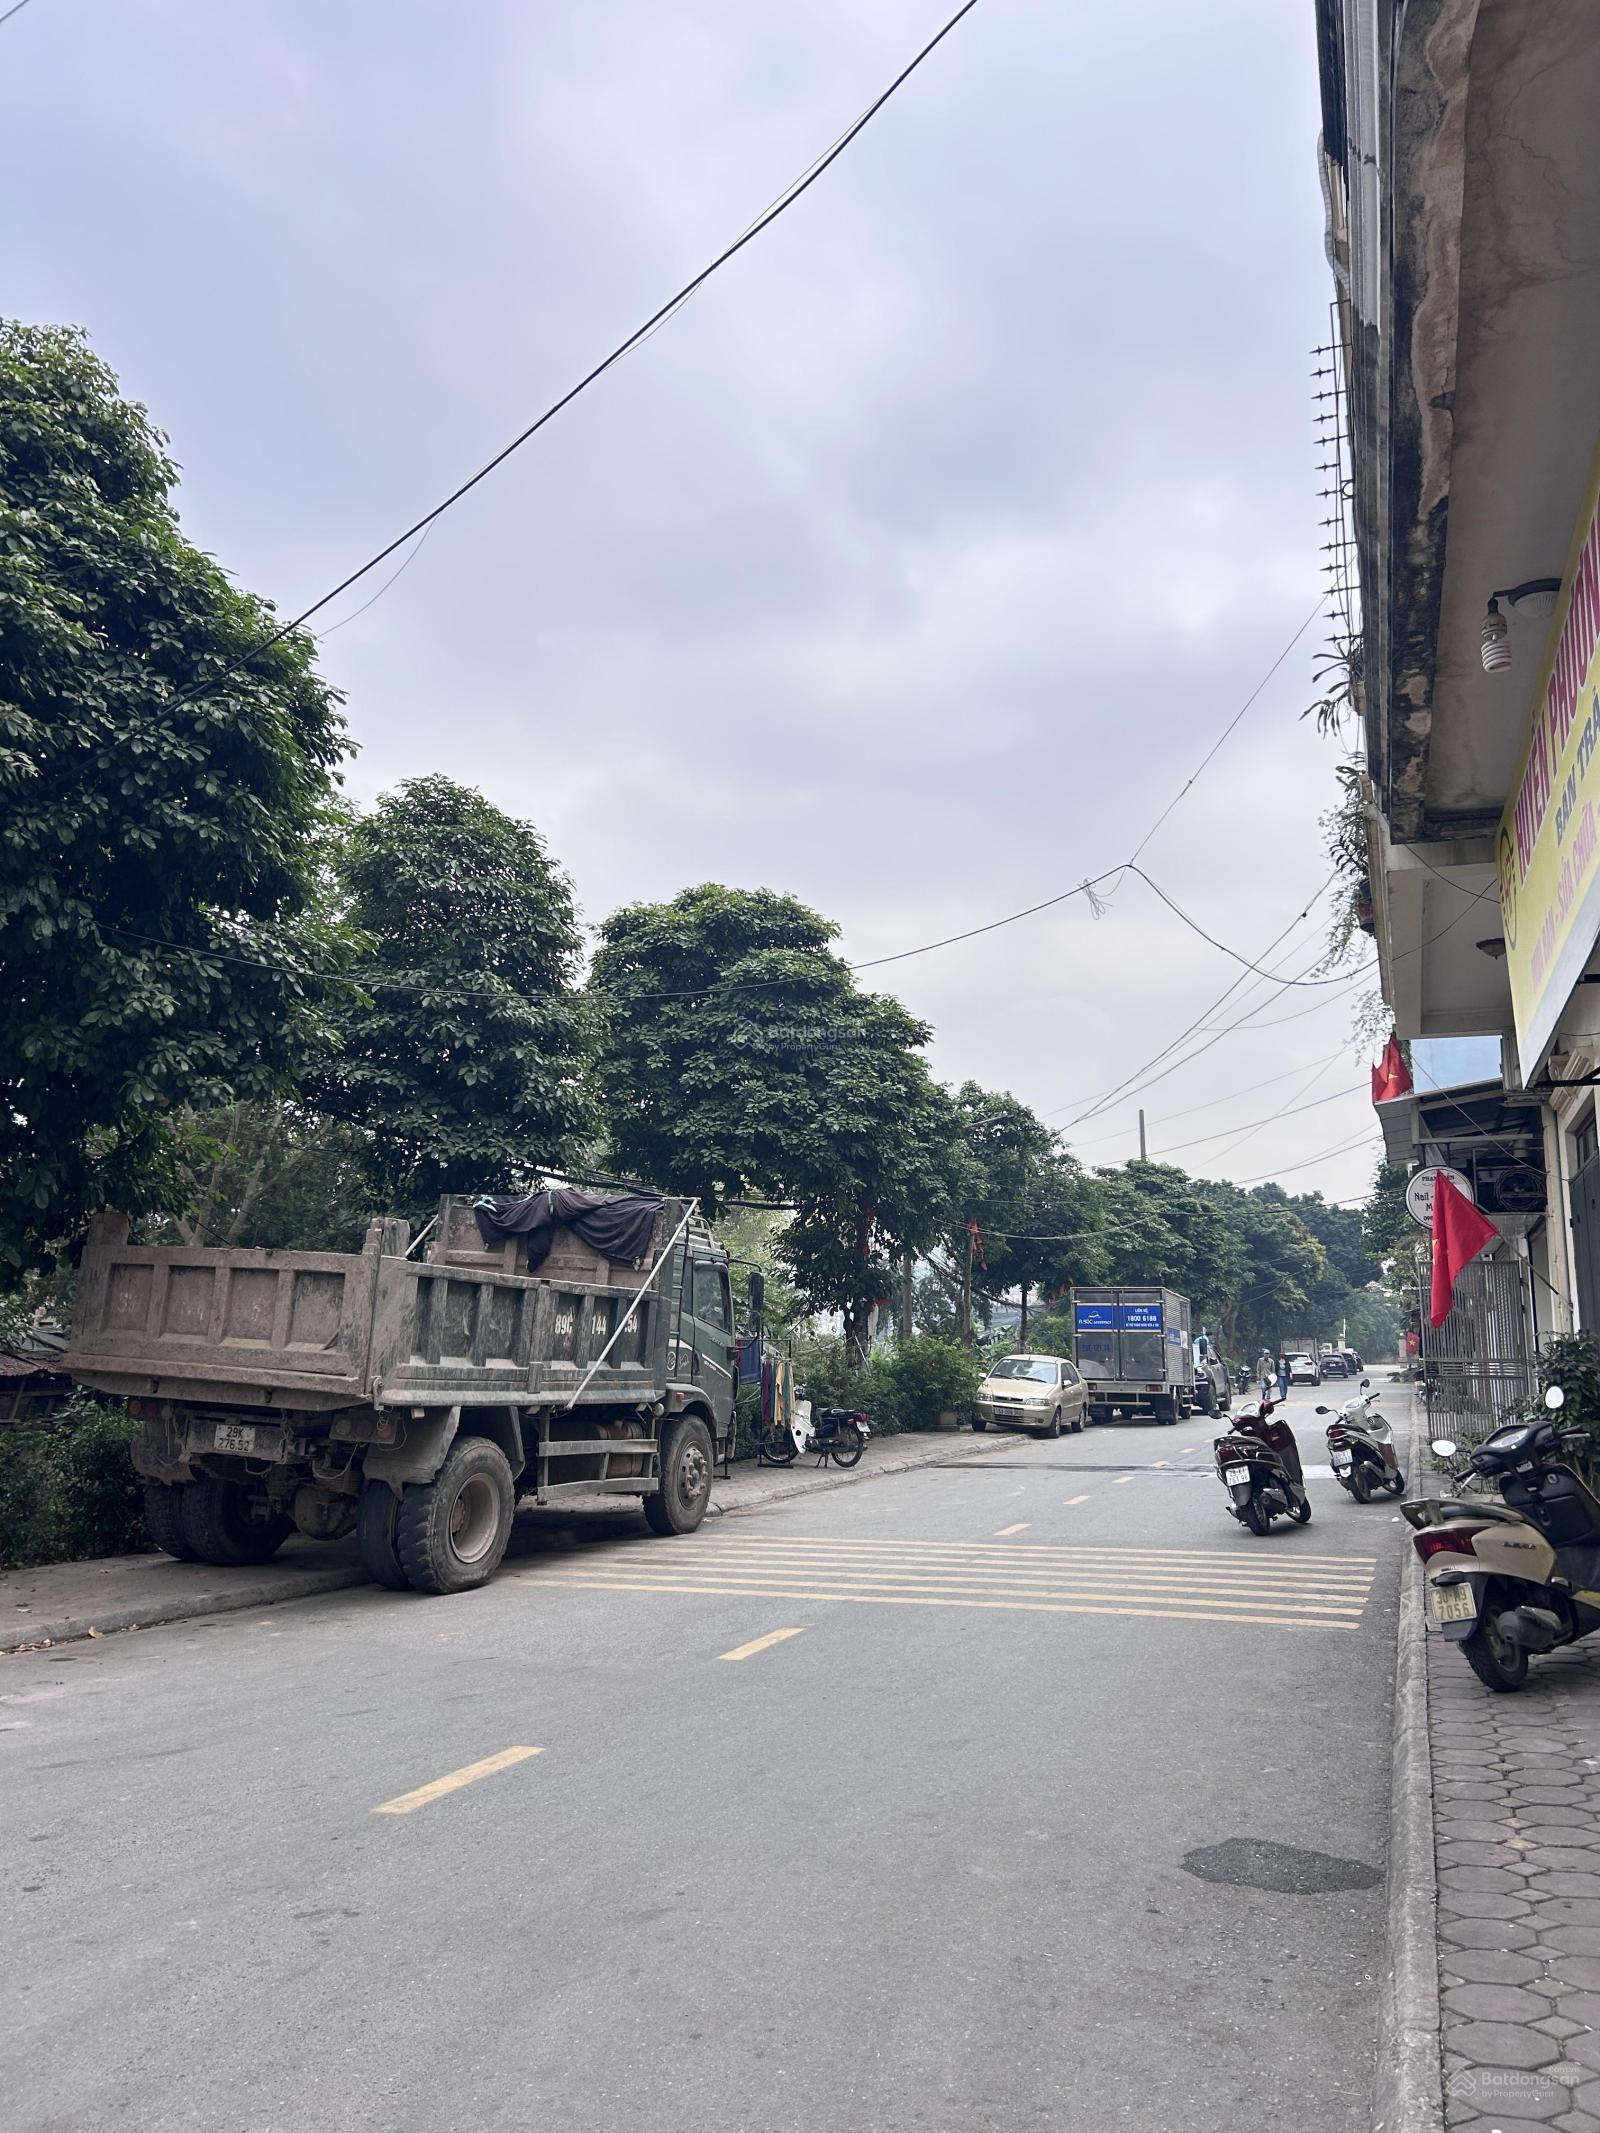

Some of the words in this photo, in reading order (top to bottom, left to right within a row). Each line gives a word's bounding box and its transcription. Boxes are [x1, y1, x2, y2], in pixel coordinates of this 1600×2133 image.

[1548, 490, 1600, 778] PHƯƠN
[1414, 1192, 1429, 1201] Nail
[591, 1315, 607, 1335] 144
[226, 1427, 245, 1439] 29K
[218, 1437, 250, 1452] 276.52
[1438, 1602, 1470, 1620] 7056
